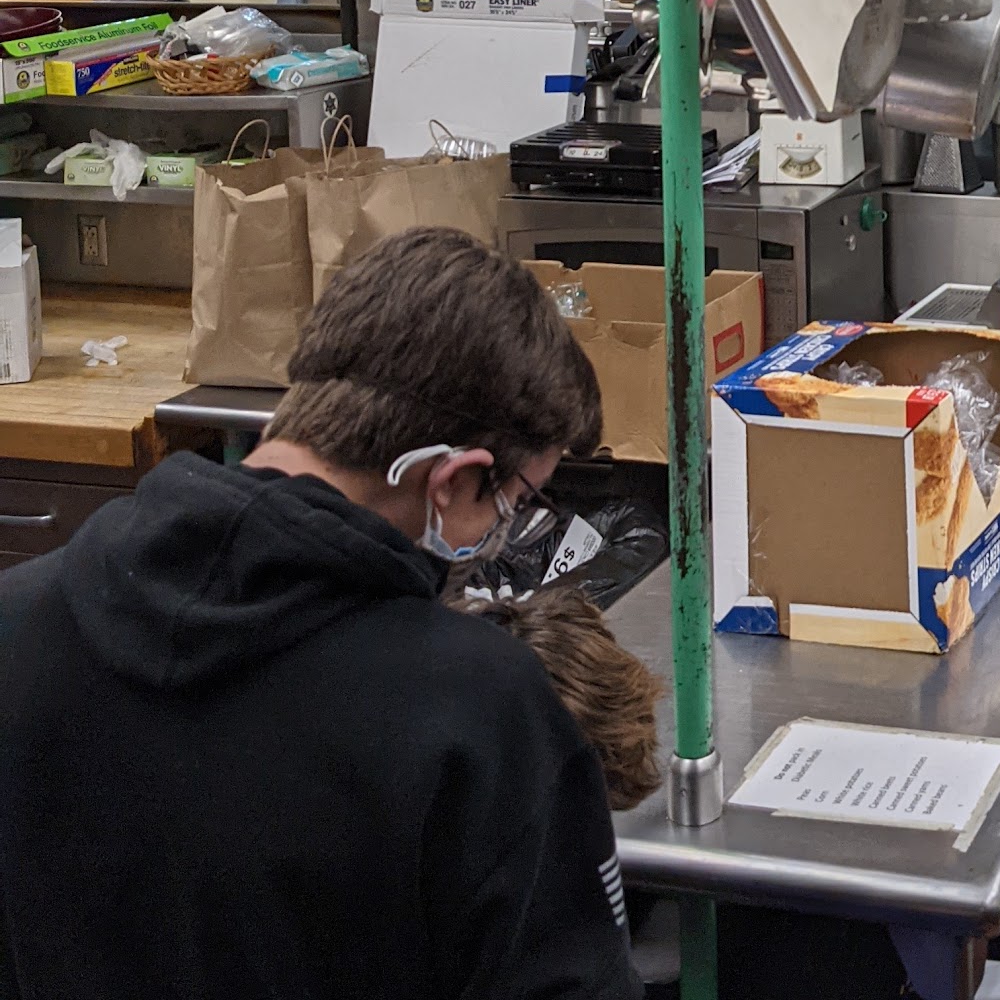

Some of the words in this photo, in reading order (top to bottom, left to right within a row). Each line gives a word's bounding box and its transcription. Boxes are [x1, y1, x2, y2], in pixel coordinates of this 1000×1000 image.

[459, 0, 476, 10] 027
[38, 33, 97, 51] Foodservice
[99, 25, 142, 40] Aluminum
[143, 21, 158, 32] Foil
[77, 67, 90, 79] 750
[158, 164, 183, 174] VINYL
[970, 553, 990, 587] STRIPS
[782, 764, 792, 772] not
[789, 753, 800, 764] pack
[791, 763, 811, 782] Diabetic
[832, 790, 849, 804] White
[845, 768, 864, 789] potatoes
[886, 791, 904, 810] Canned
[900, 777, 914, 792] sweet
[909, 756, 928, 777] potatoes
[796, 789, 811, 800] Peas
[814, 790, 829, 802] Corn
[851, 791, 867, 806] White
[862, 782, 874, 791] rice
[868, 789, 887, 808] Canned
[904, 793, 922, 813] Canned
[919, 780, 931, 793] yams
[922, 798, 939, 814] Baked
[932, 784, 948, 799] beans
